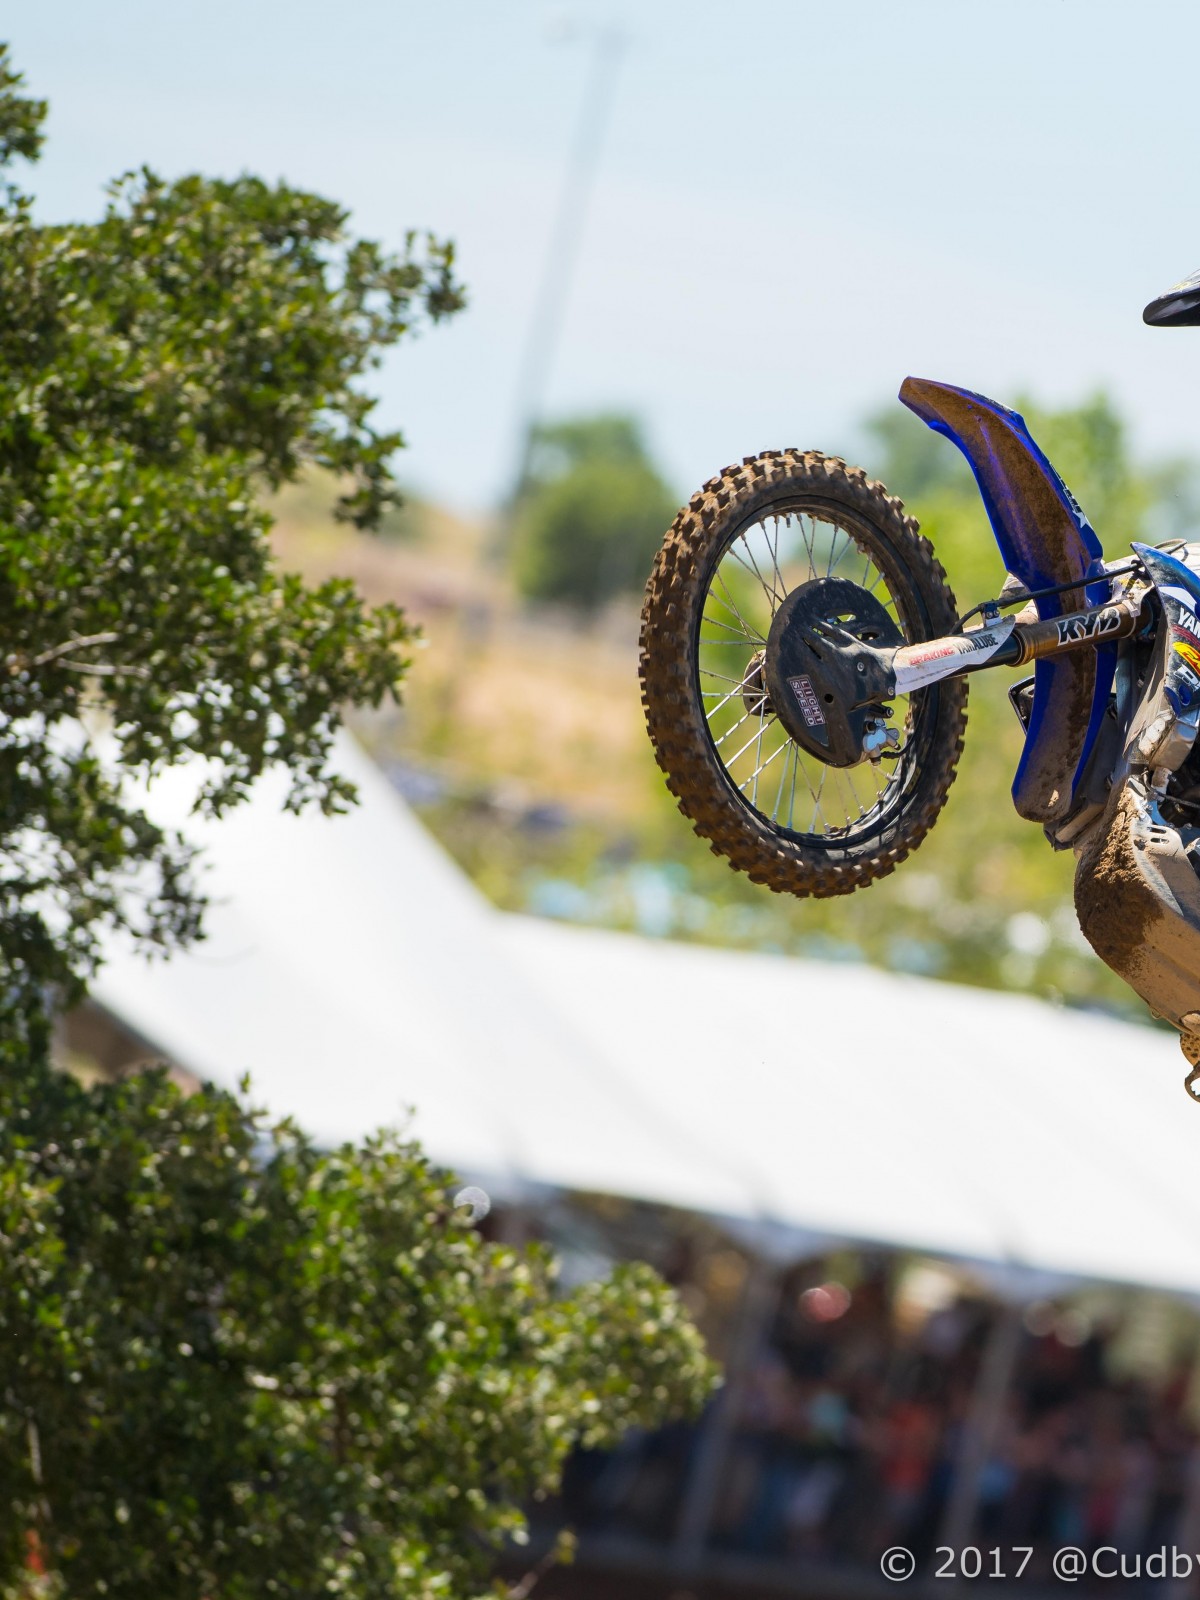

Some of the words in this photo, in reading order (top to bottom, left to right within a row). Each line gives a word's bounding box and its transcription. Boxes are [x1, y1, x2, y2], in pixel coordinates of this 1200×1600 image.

[956, 633, 999, 655] YAMALUBE
[1055, 607, 1121, 647] KYB
[909, 646, 955, 665] BRAKING
[792, 681, 815, 725] SPEED
[801, 680, 824, 723] LIGHT
